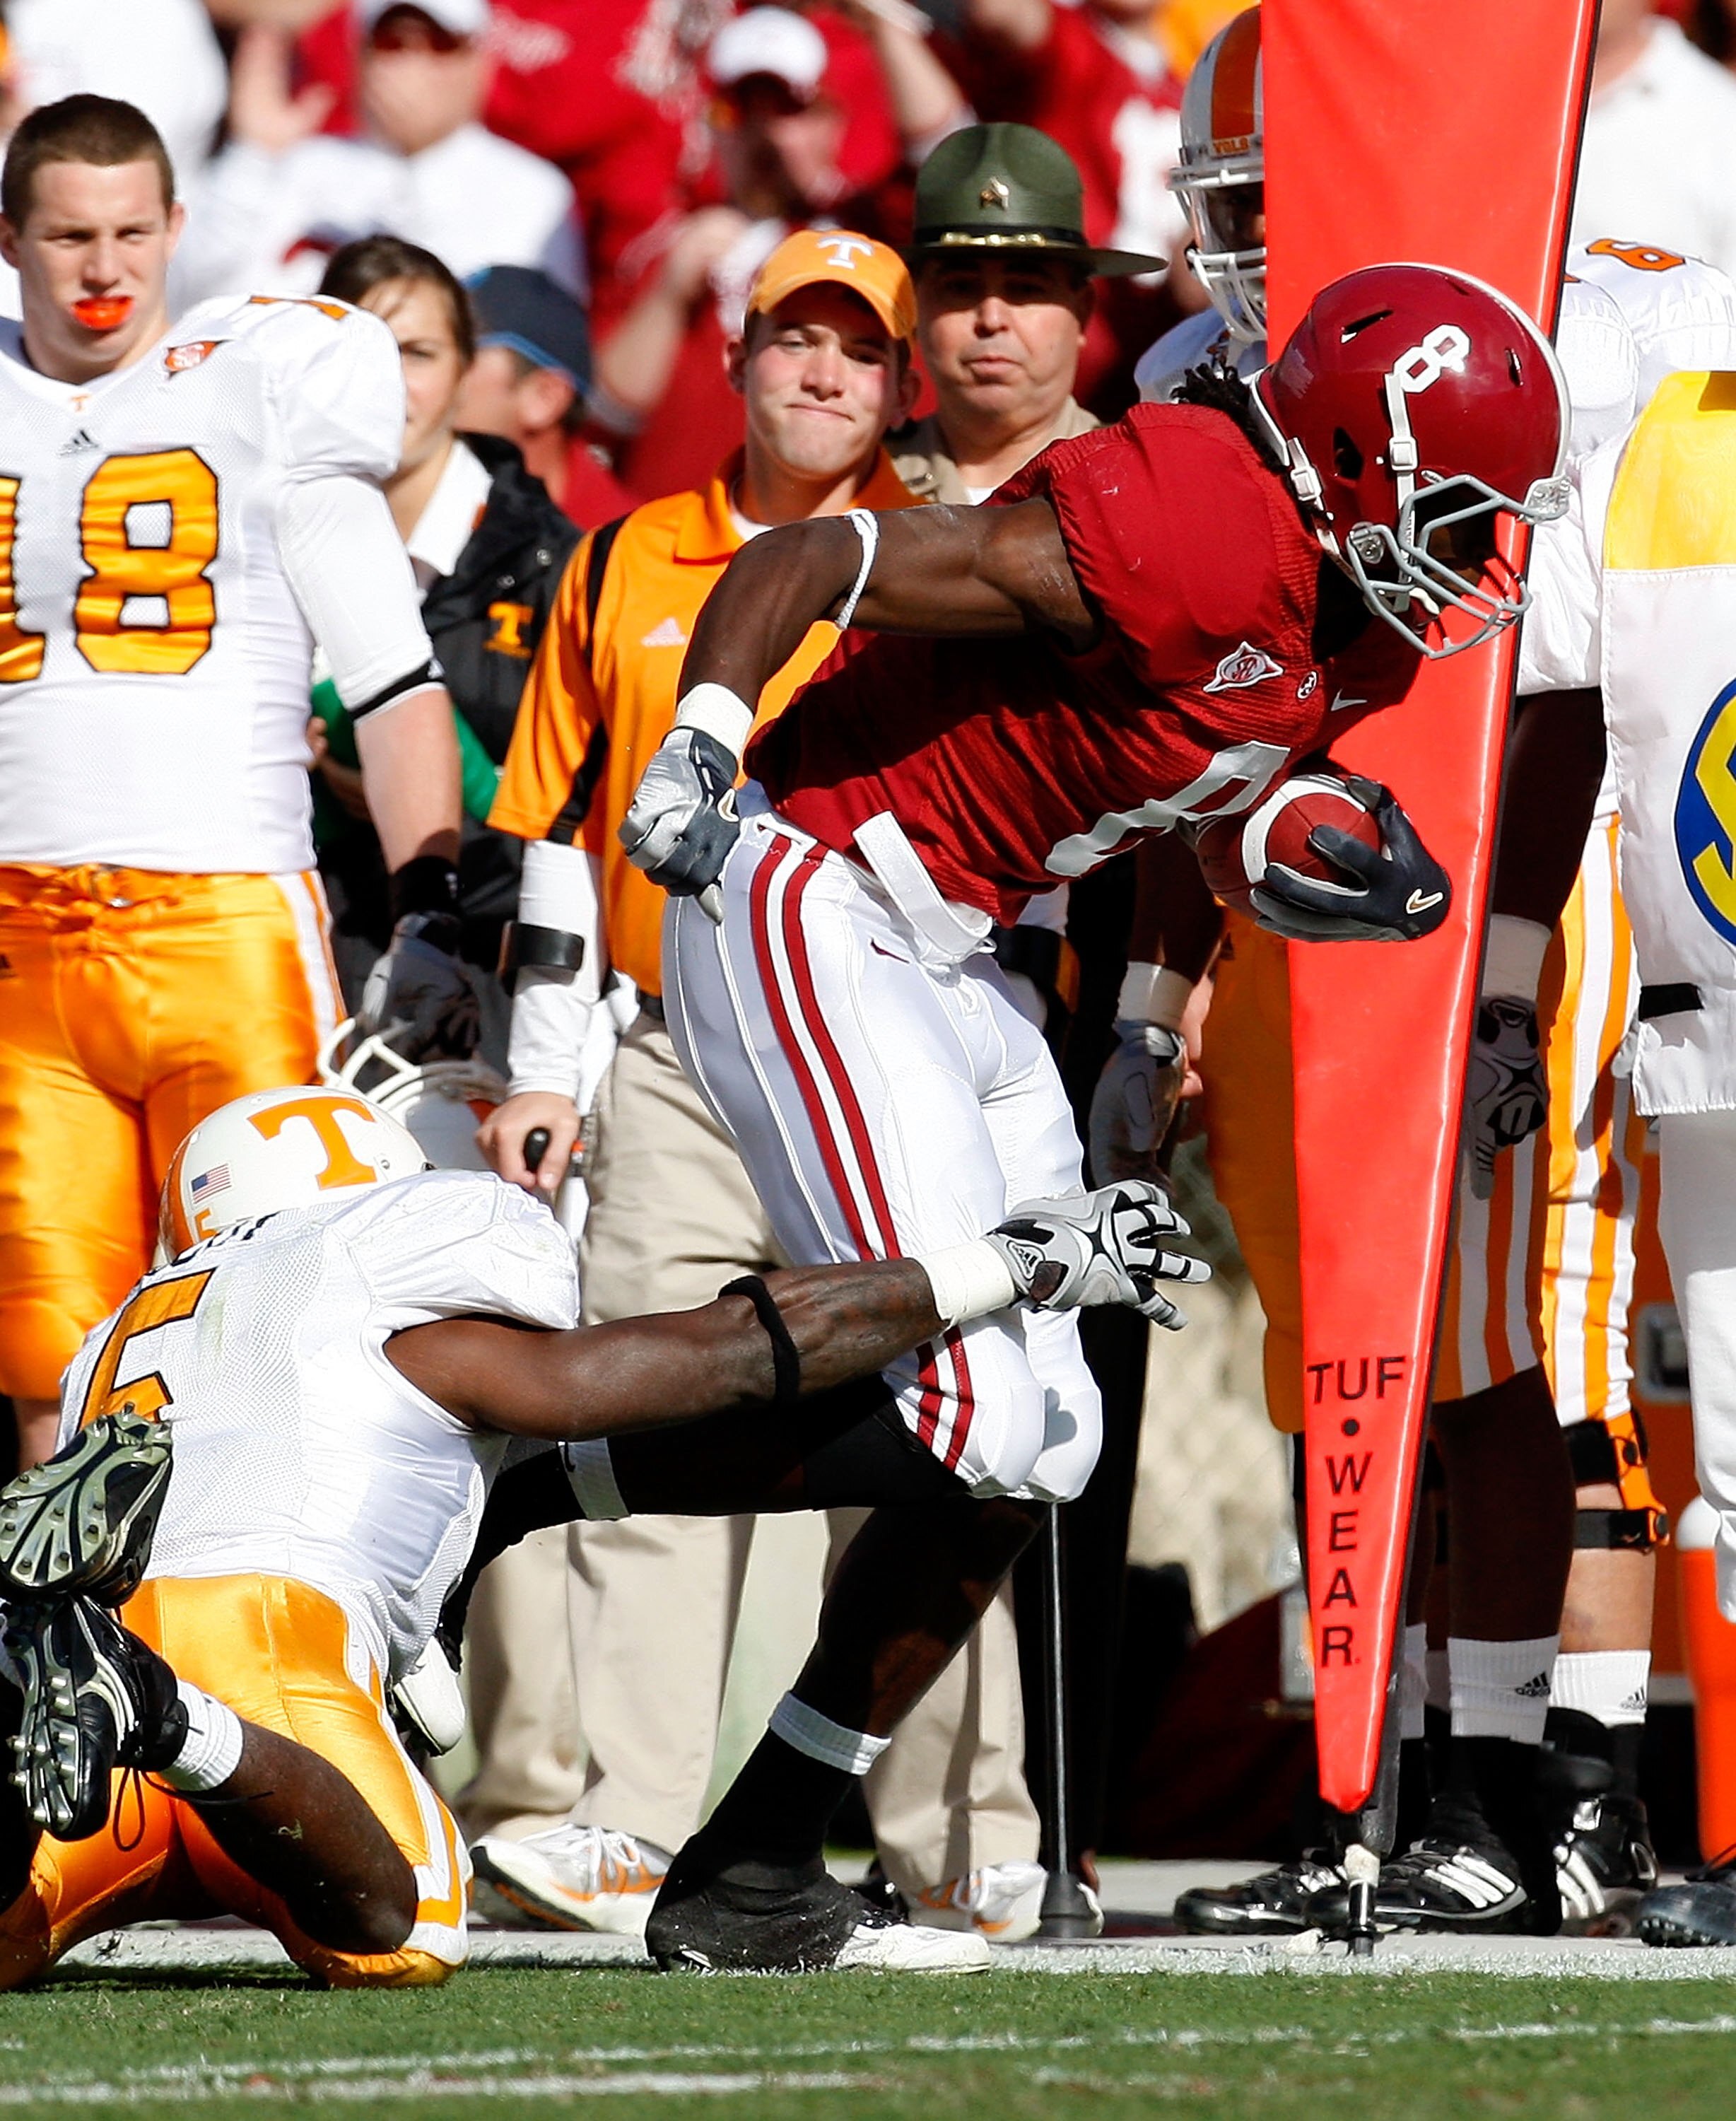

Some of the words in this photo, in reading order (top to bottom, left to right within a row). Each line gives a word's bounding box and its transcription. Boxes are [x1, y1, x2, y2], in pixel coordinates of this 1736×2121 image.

[816, 235, 873, 269] T
[1392, 324, 1471, 393] 8
[71, 394, 92, 412] T
[247, 1096, 378, 1191] T
[1307, 1356, 1405, 1403] TUF
[1321, 1451, 1373, 1667] WEAR
